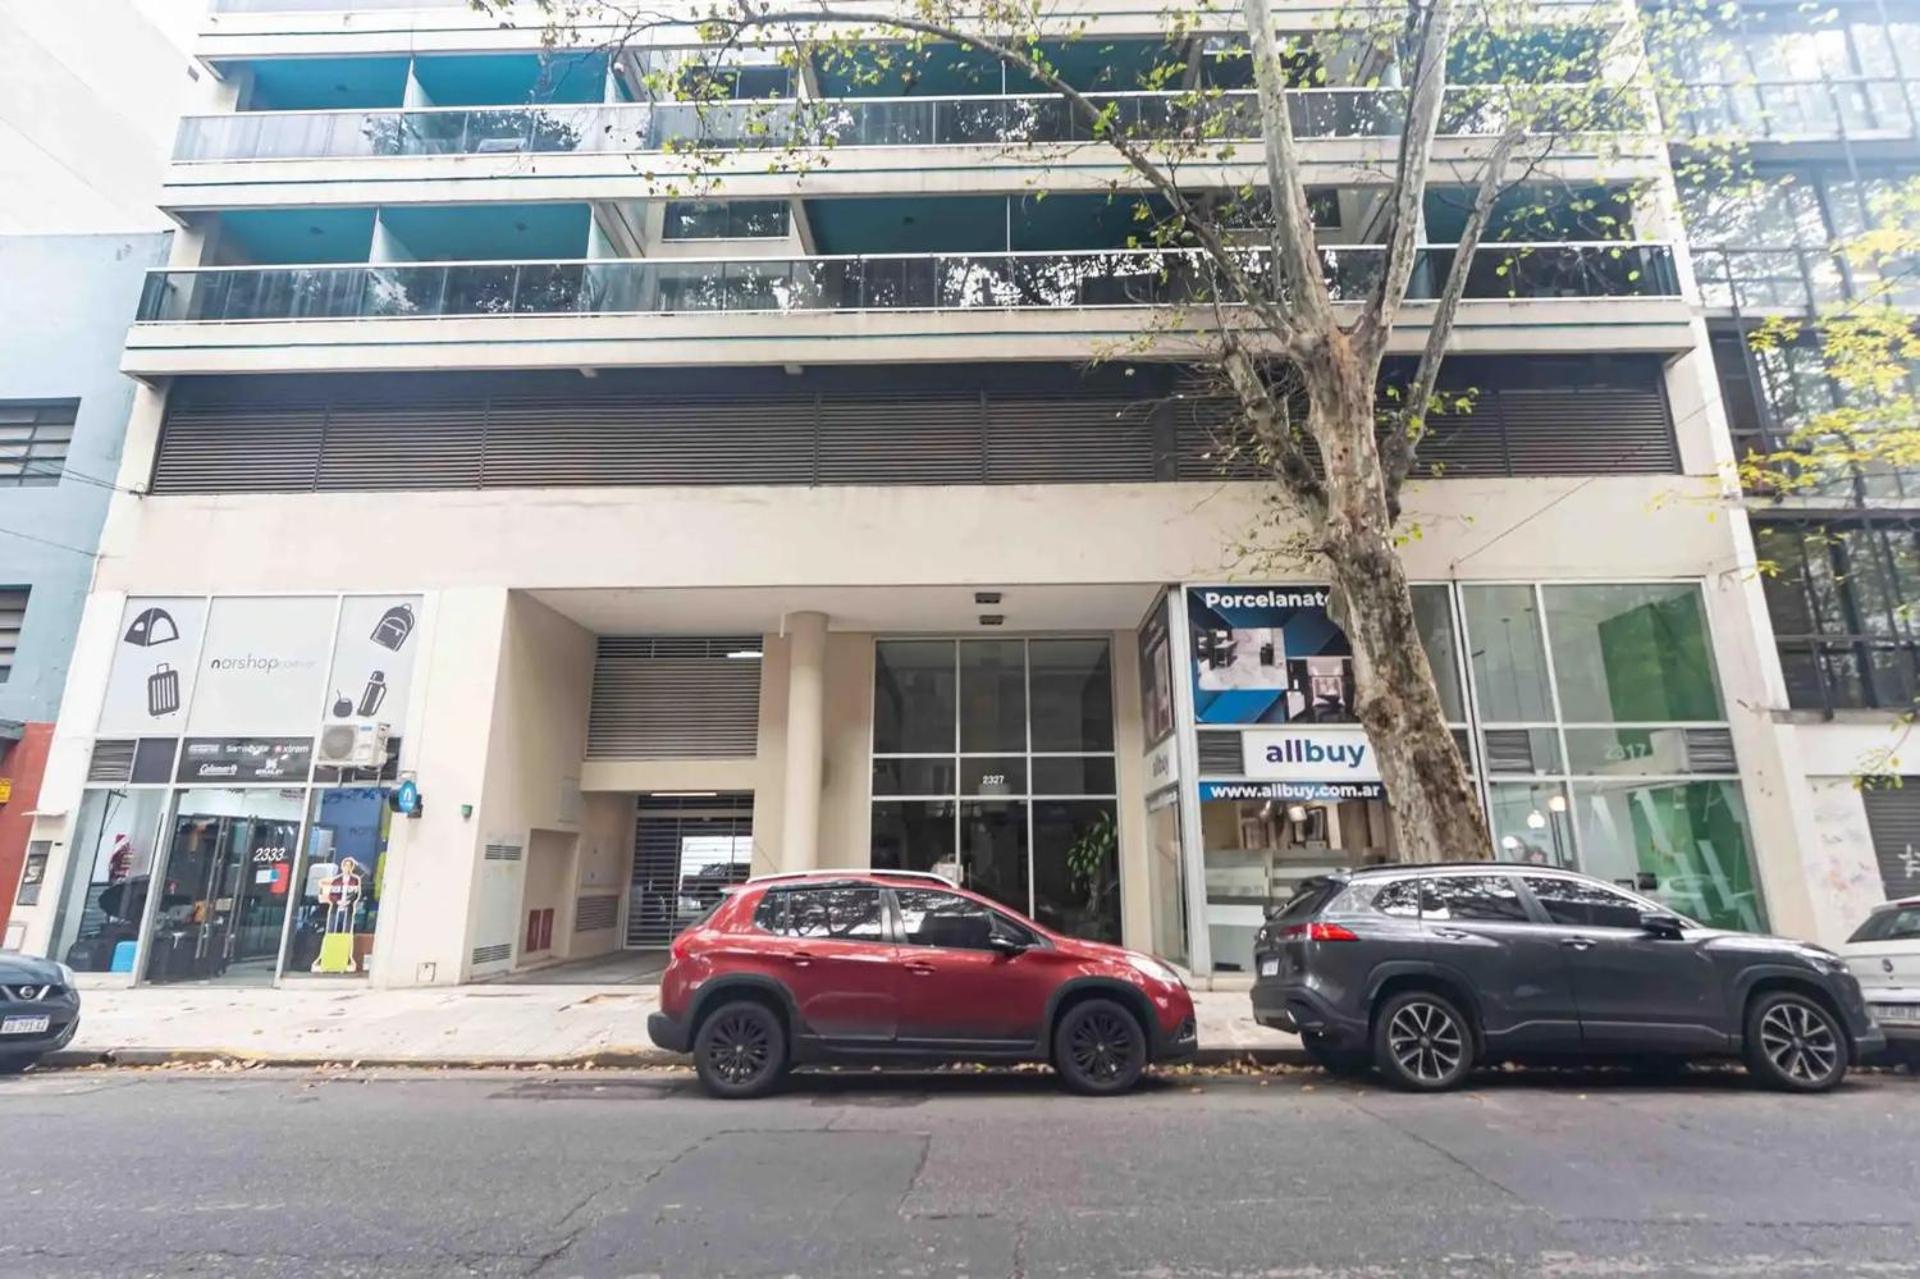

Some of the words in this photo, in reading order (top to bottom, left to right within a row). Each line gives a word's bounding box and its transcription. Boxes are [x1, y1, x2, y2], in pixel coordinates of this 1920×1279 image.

[1205, 591, 1329, 608] Porcelanat
[211, 653, 279, 673] norshop
[1266, 739, 1365, 768] allbuy
[982, 775, 1005, 785] 2327
[1210, 784, 1381, 800] www.allbuy.com.ar
[253, 847, 286, 862] 2333
